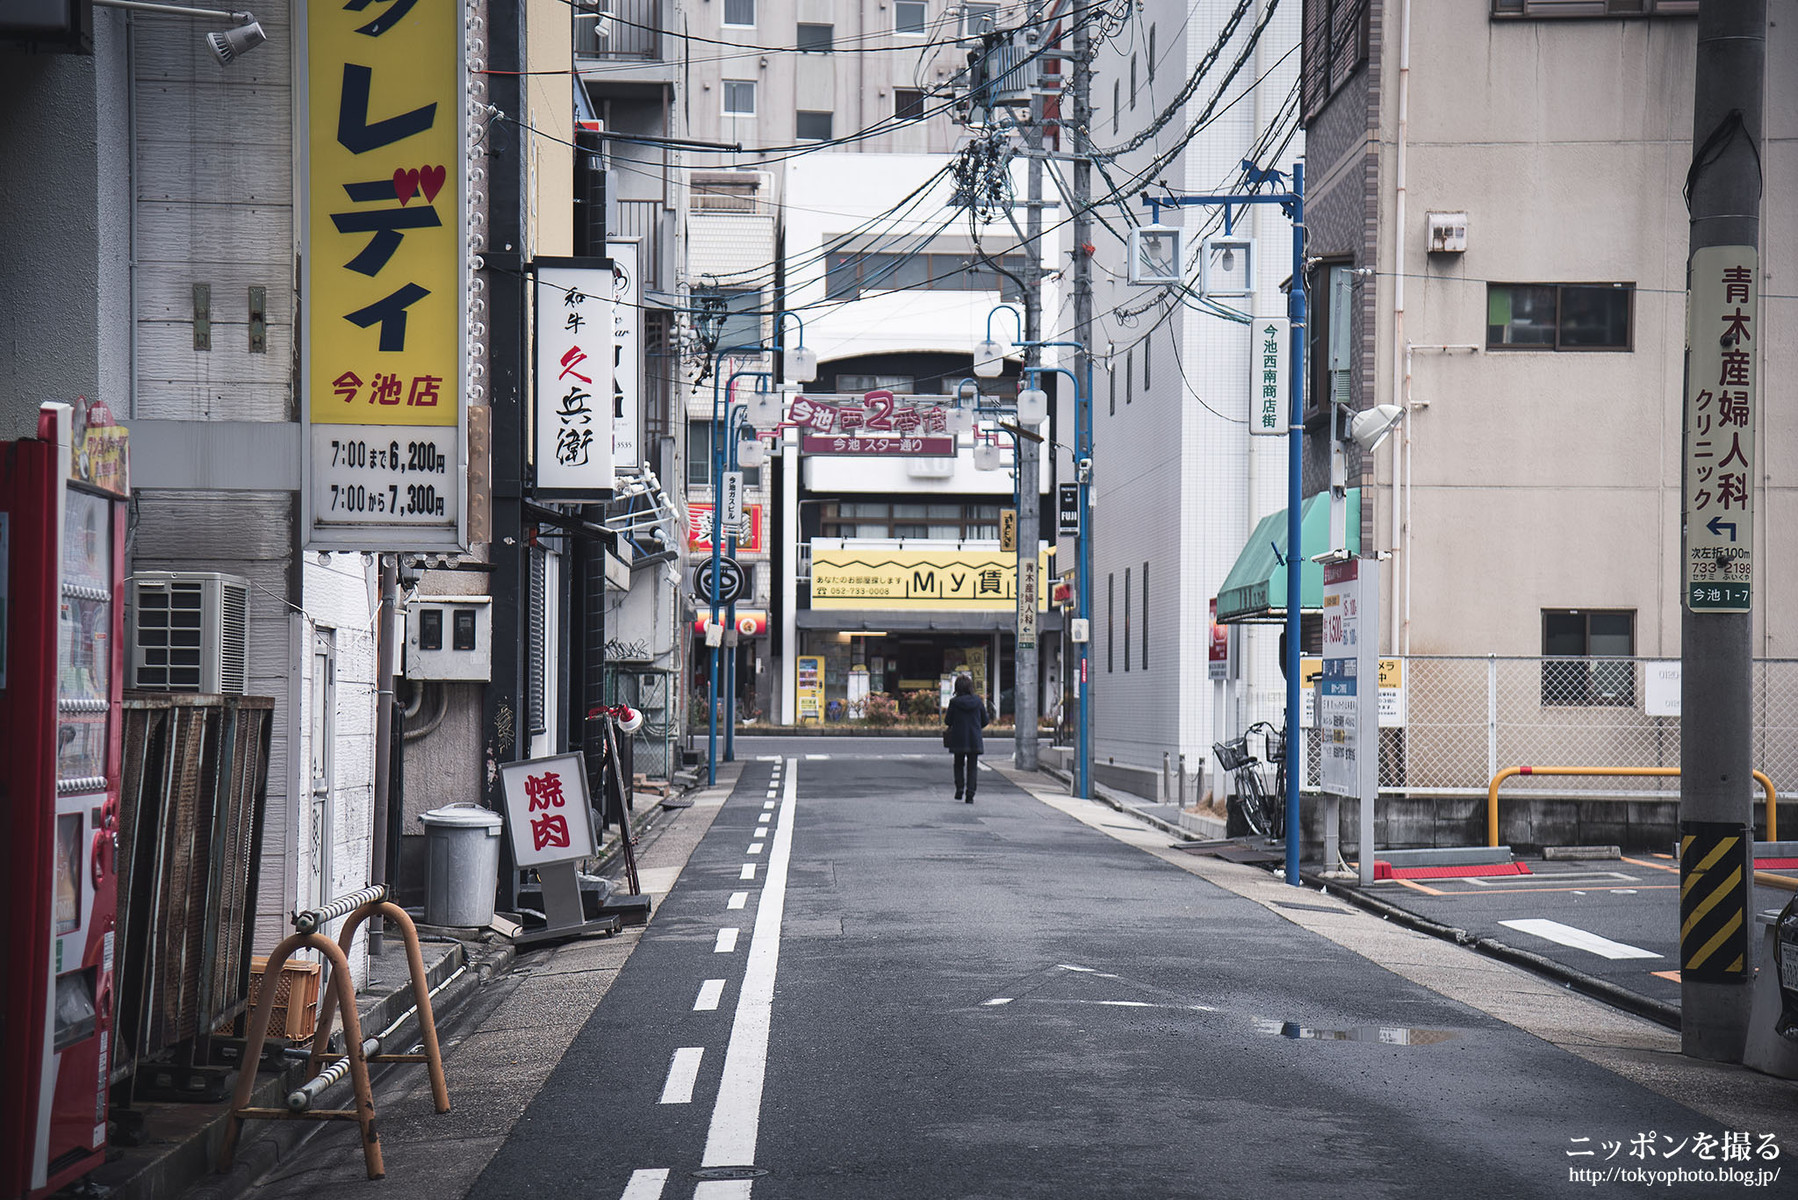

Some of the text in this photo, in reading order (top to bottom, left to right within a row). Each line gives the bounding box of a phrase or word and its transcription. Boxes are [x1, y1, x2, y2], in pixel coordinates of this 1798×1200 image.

[332, 371, 443, 406] 今池店
[555, 286, 592, 466] 和牛 久兵衛
[1261, 323, 1278, 428] 今池西南商店街
[1717, 265, 1752, 510] 青木産婦人科
[1694, 389, 1713, 510] クリニック
[1061, 511, 1077, 521] FUJI
[1691, 547, 1750, 559] 次左折100m
[830, 587, 890, 595] 052-733-0008
[912, 569, 1018, 595] My賃
[524, 771, 570, 851] 焼肉
